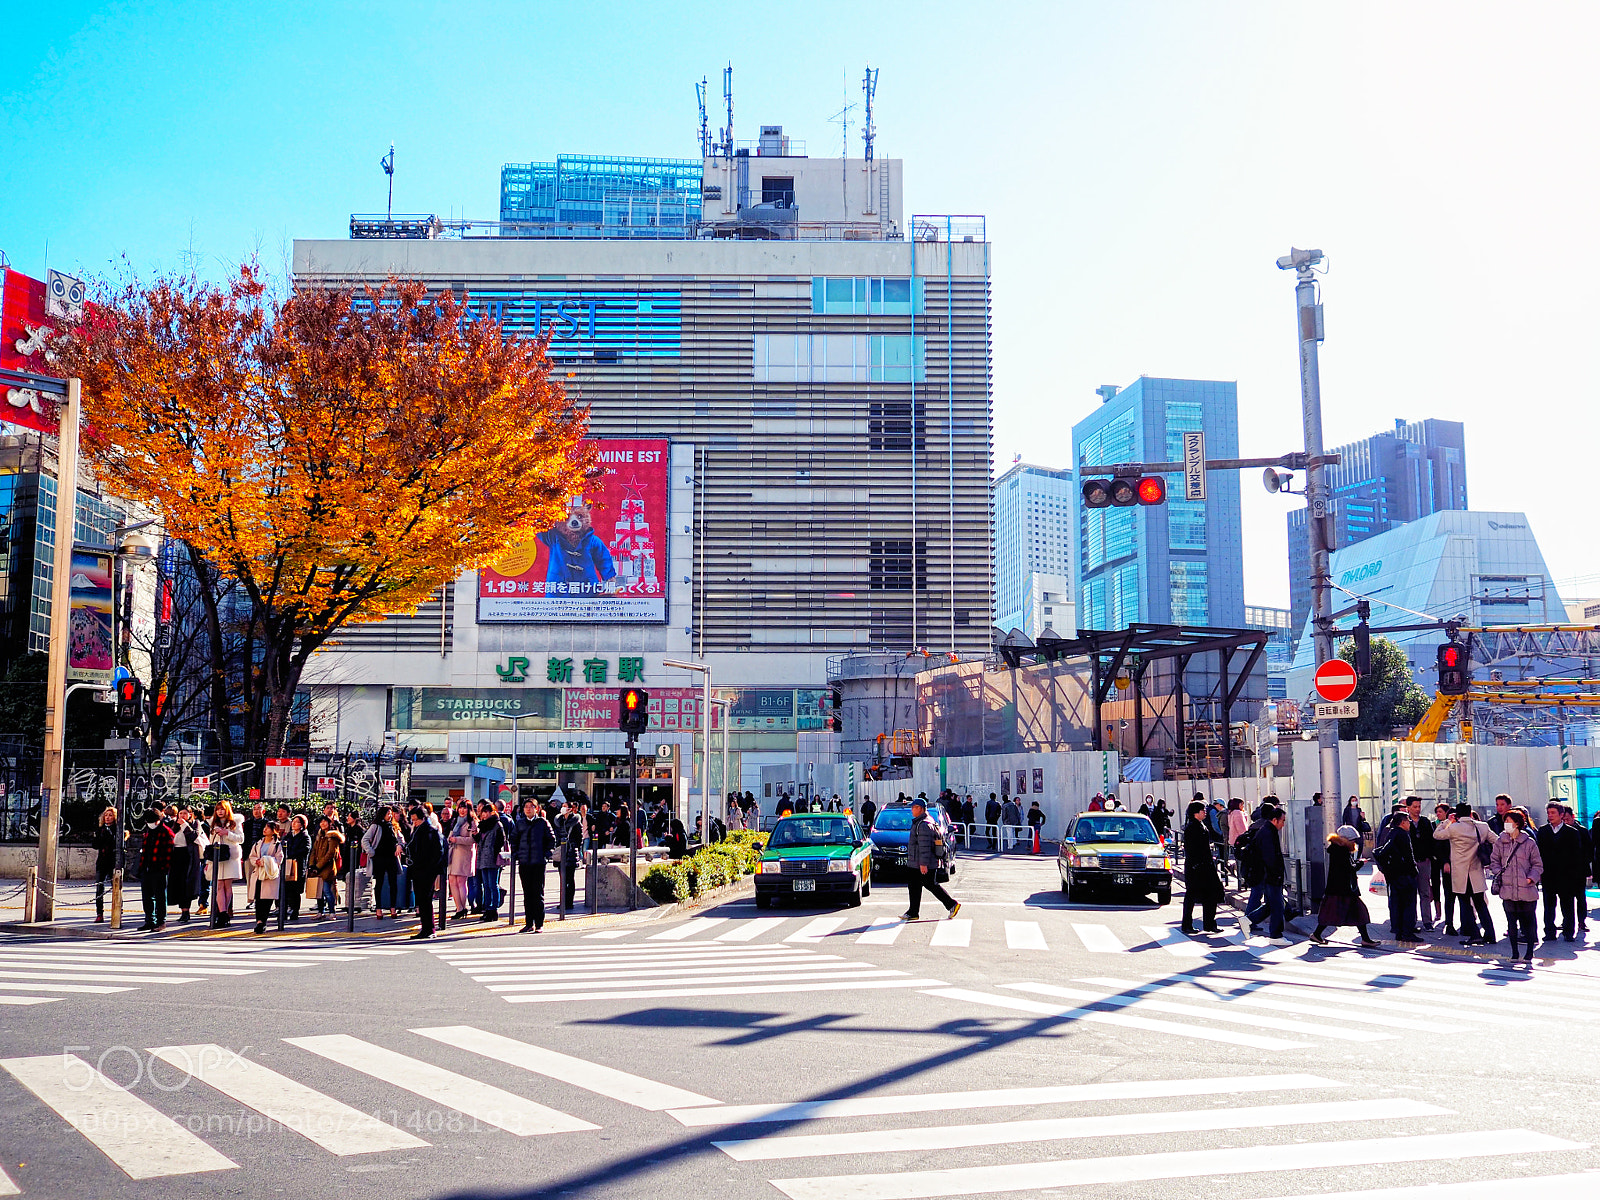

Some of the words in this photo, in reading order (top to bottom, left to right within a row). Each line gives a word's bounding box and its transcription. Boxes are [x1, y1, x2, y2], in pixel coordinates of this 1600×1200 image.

[637, 450, 662, 463] EST
[1189, 435, 1202, 497] スクランブル交差点
[485, 580, 517, 593] 1.19
[496, 656, 529, 676] JR
[547, 656, 645, 683] 新宿駅
[567, 690, 620, 701] Welcome
[437, 699, 521, 709] STARBUCKS
[567, 701, 579, 709] to
[761, 696, 790, 706] B1-6F
[567, 710, 611, 719] LUMINE
[1318, 706, 1355, 716] 自転車を除く
[567, 720, 587, 728] EST
[548, 741, 593, 749] 新宿駅東口
